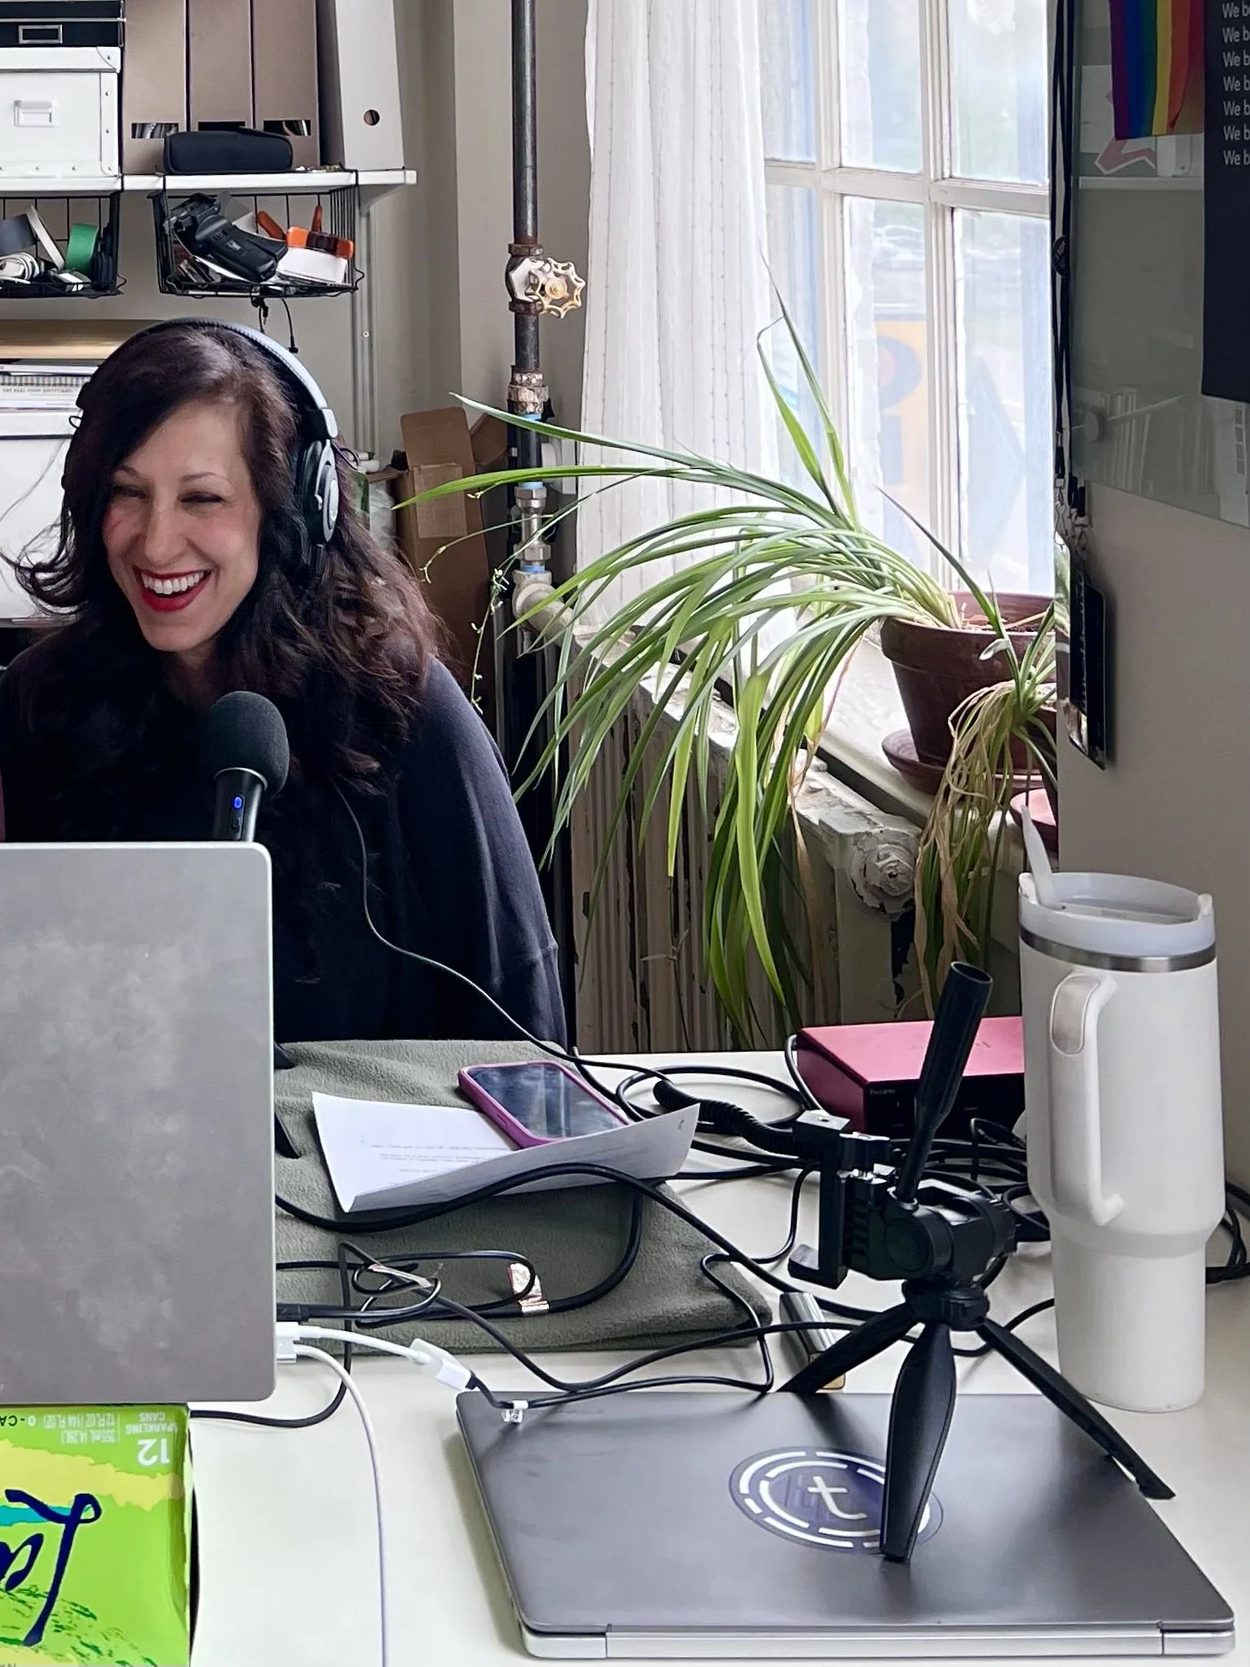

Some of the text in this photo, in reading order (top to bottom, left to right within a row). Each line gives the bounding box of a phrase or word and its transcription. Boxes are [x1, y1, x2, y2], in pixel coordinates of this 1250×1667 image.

[1222, 3, 1239, 19] We
[1222, 28, 1240, 43] We
[1223, 52, 1240, 67] We
[1223, 76, 1240, 91] We
[1223, 101, 1240, 116] We
[1223, 125, 1240, 141] We
[1223, 150, 1240, 165] We
[139, 1412, 165, 1422] CANS
[126, 1422, 178, 1434] SPARKLING
[137, 1438, 170, 1466] 12
